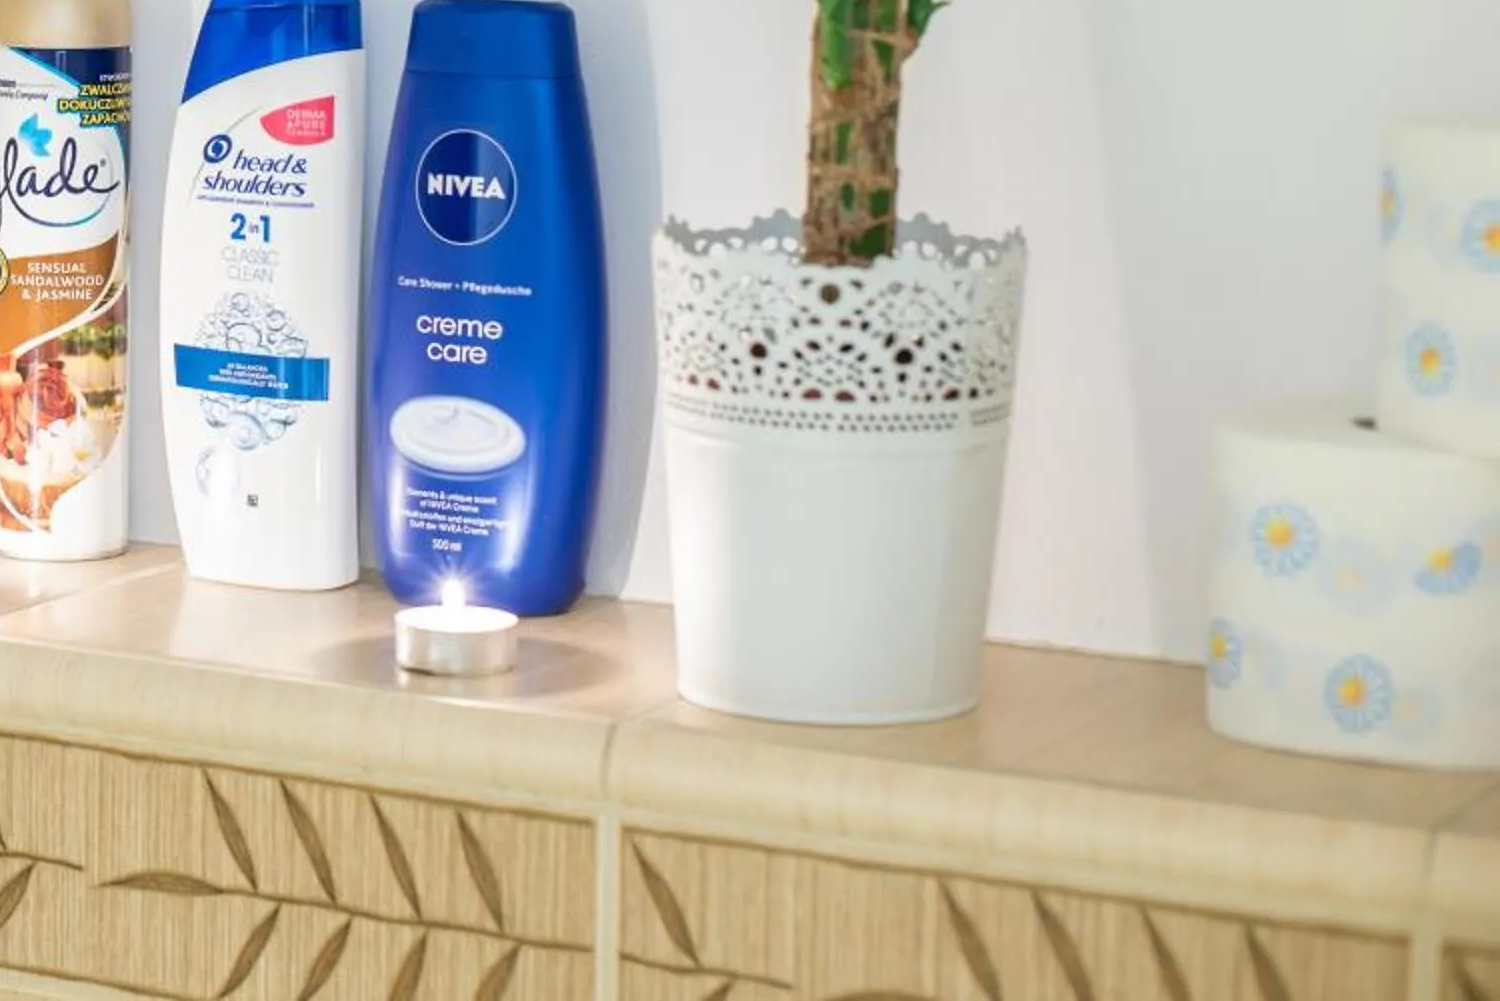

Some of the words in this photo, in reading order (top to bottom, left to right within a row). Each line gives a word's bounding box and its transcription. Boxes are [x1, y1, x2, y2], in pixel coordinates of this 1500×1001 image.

[202, 170, 306, 197] shoulders
[427, 173, 506, 200] NIVEA
[27, 262, 87, 274] SENSUAL
[227, 264, 274, 283] CLEAN
[10, 273, 105, 288] SANDALWOOD
[36, 288, 93, 302] JASMINE
[416, 315, 504, 340] creme
[427, 342, 488, 365] care
